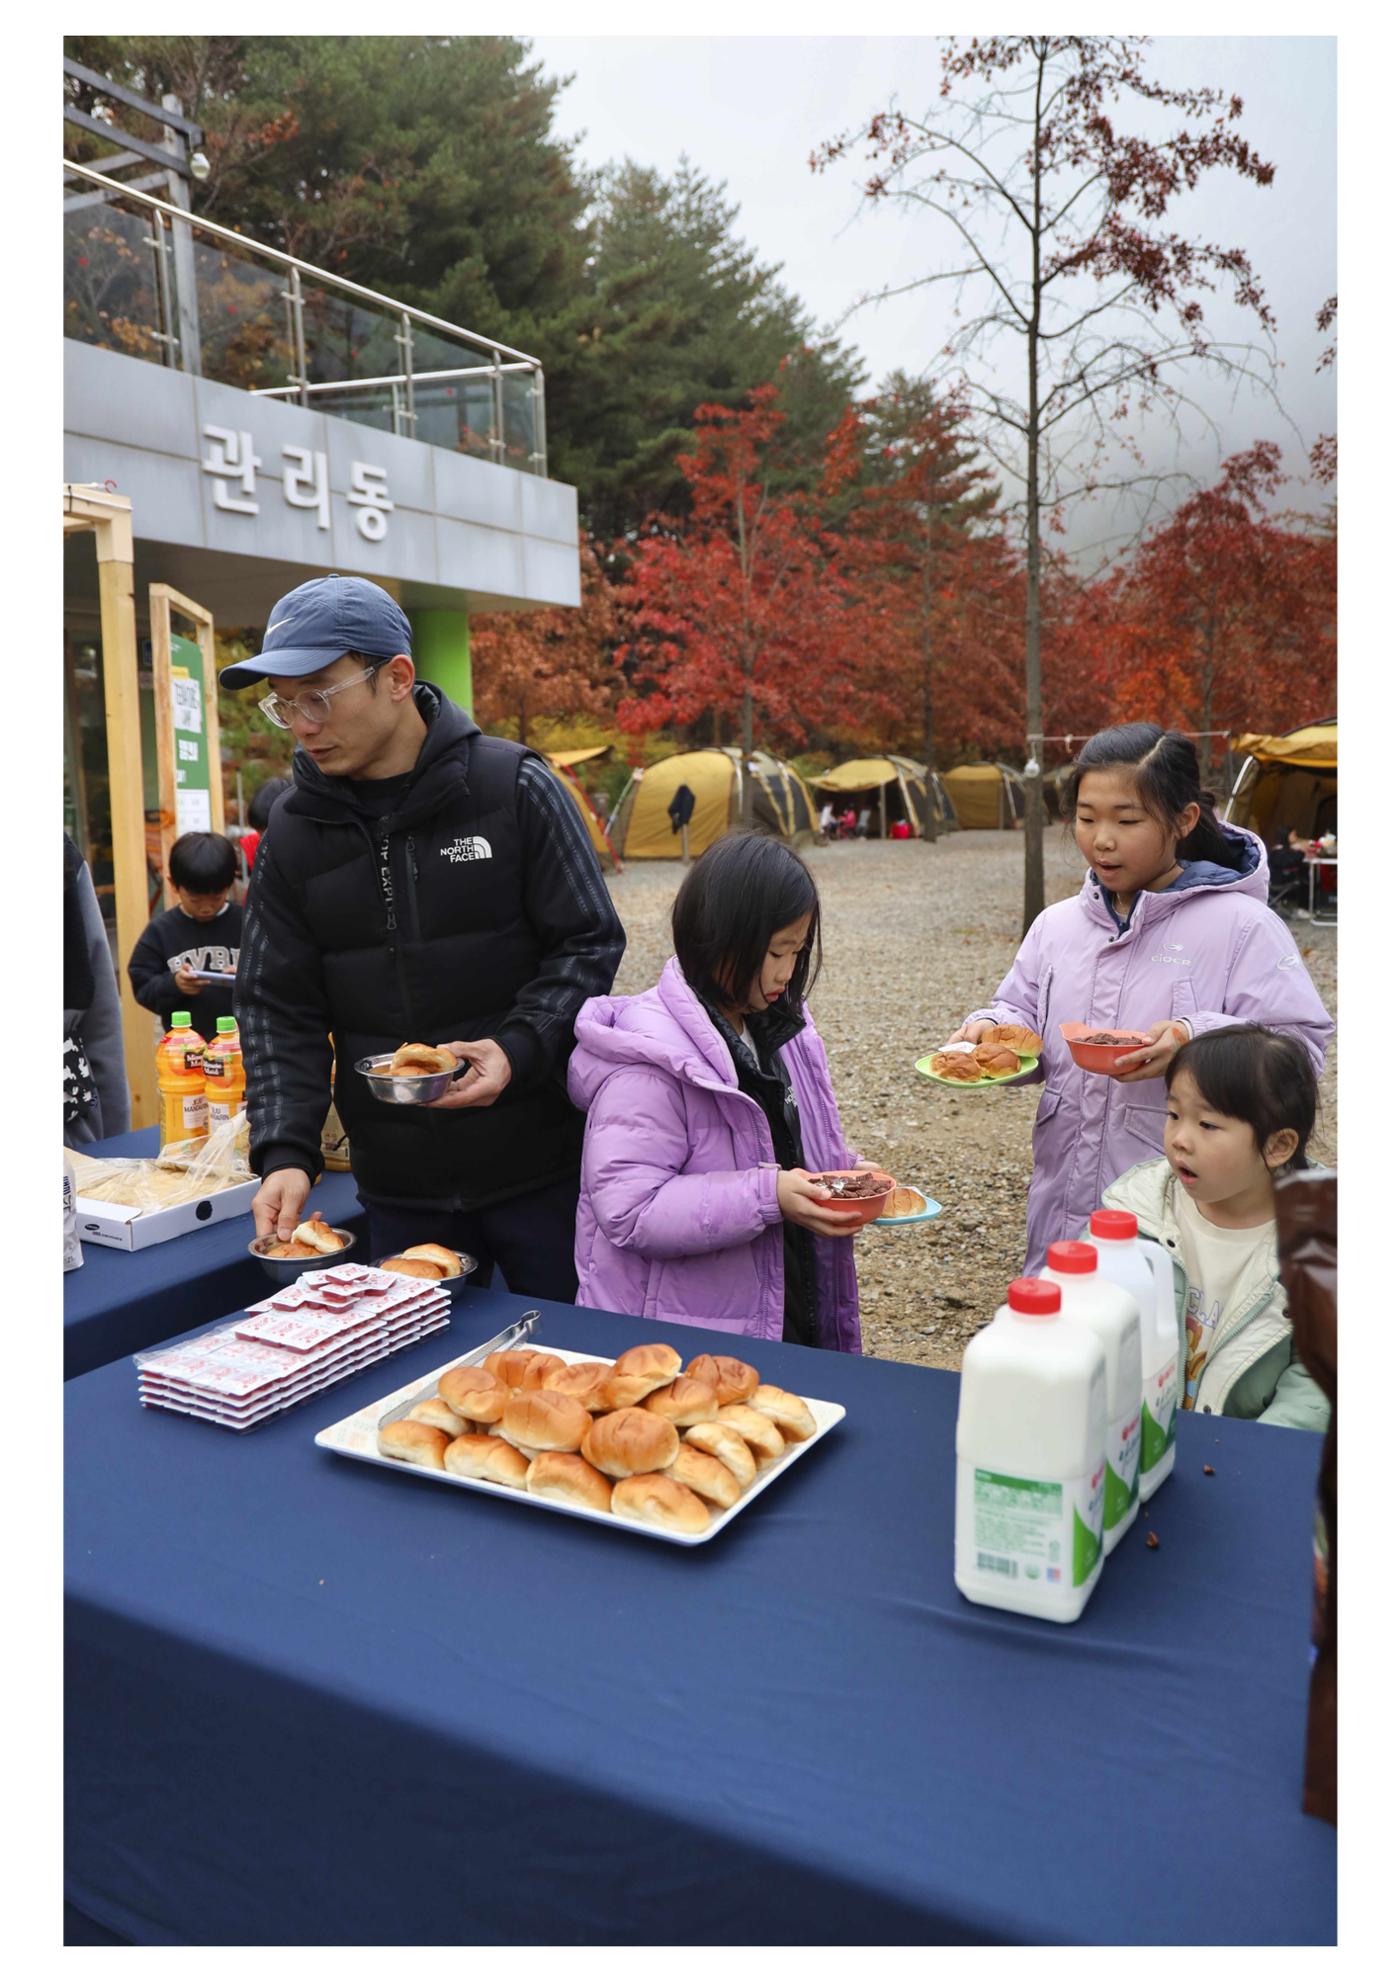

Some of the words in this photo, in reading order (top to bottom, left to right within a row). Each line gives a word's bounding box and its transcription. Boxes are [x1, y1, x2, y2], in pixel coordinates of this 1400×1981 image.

[202, 423, 394, 542] 관리동
[453, 836, 473, 846] THE
[440, 844, 474, 856] NORTH
[450, 852, 475, 863] FACE
